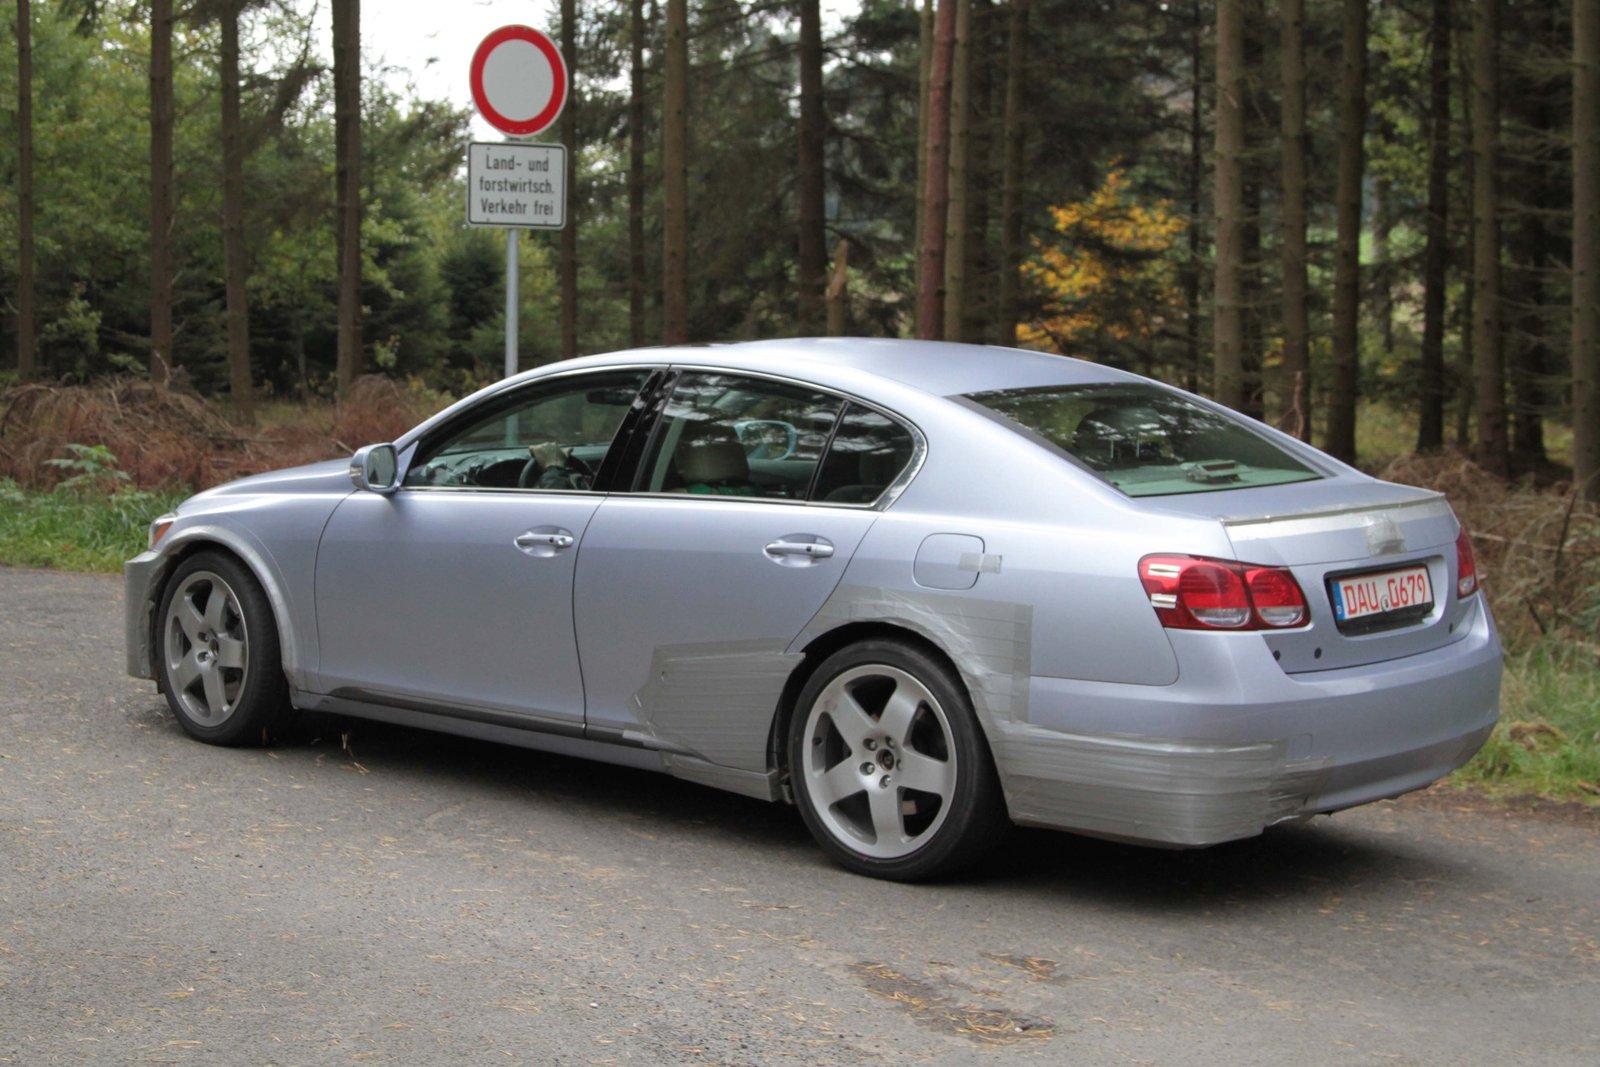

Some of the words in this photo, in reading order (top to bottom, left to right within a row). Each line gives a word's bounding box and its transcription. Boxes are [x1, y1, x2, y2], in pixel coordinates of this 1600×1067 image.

[486, 154, 522, 170] Land-
[528, 156, 549, 172] und
[479, 176, 554, 194] forstwirtsch.
[481, 197, 527, 215] Verkehr
[534, 200, 554, 216] frei
[1343, 581, 1379, 616] DAU
